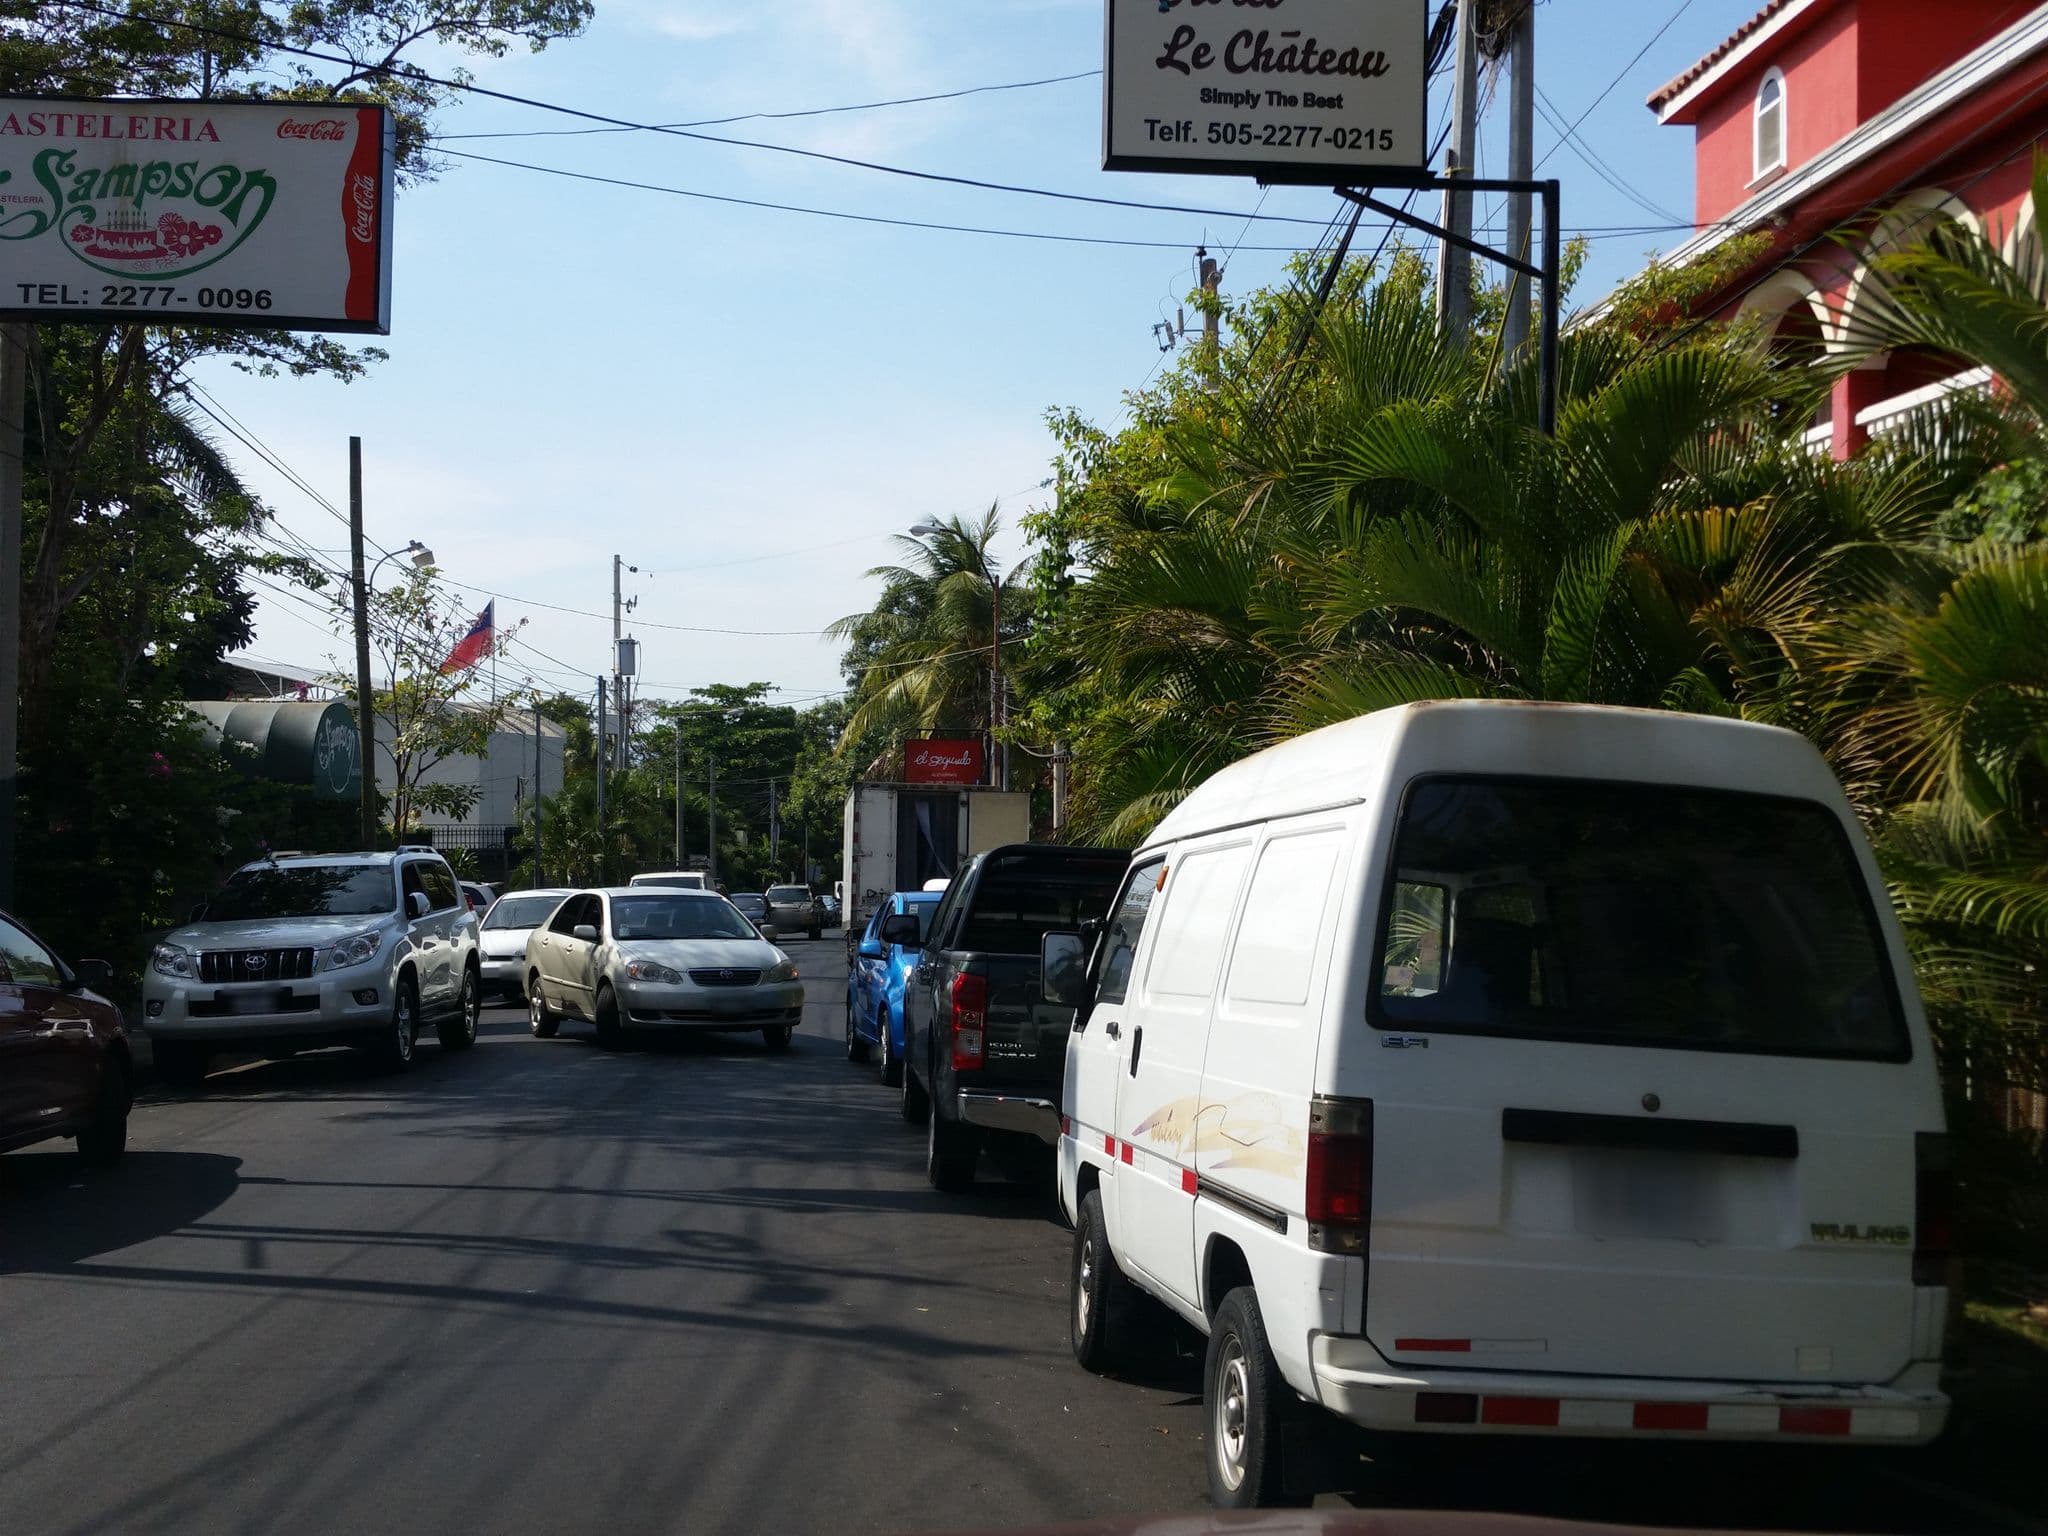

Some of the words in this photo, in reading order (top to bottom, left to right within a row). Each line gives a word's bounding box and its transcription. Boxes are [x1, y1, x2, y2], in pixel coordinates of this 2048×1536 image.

[1156, 24, 1215, 75] Le
[1200, 88, 1261, 110] Simply
[1265, 91, 1298, 107] The
[1303, 92, 1343, 109] Best
[1144, 118, 1198, 144] Telf.
[1207, 121, 1394, 151] 505-2277-0215
[0, 195, 44, 204] STELERIA
[31, 147, 277, 236] Sampson
[17, 283, 89, 306] TEL:
